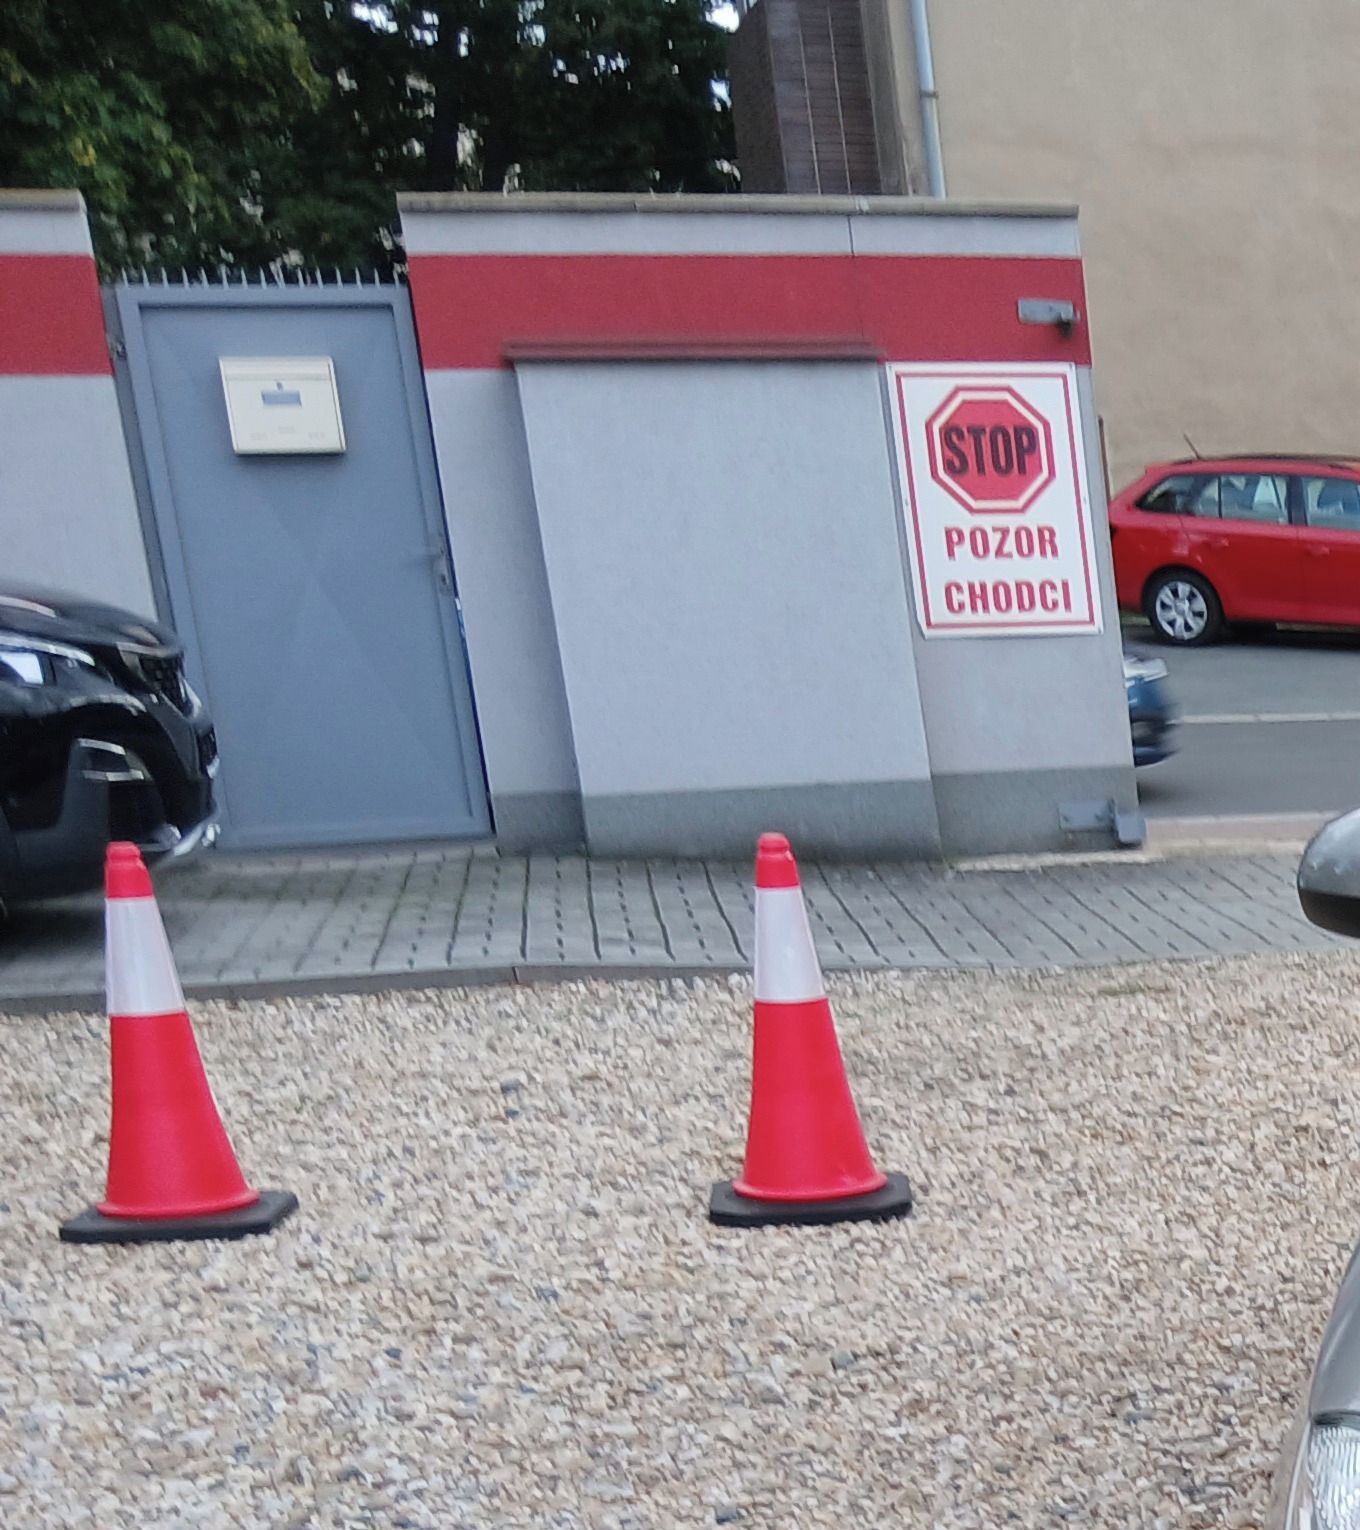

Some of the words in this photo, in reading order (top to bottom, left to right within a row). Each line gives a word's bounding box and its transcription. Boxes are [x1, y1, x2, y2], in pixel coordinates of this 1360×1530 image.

[943, 424, 1038, 476] STOP
[943, 524, 1060, 561] POZOR
[943, 578, 1073, 615] CHODCI
